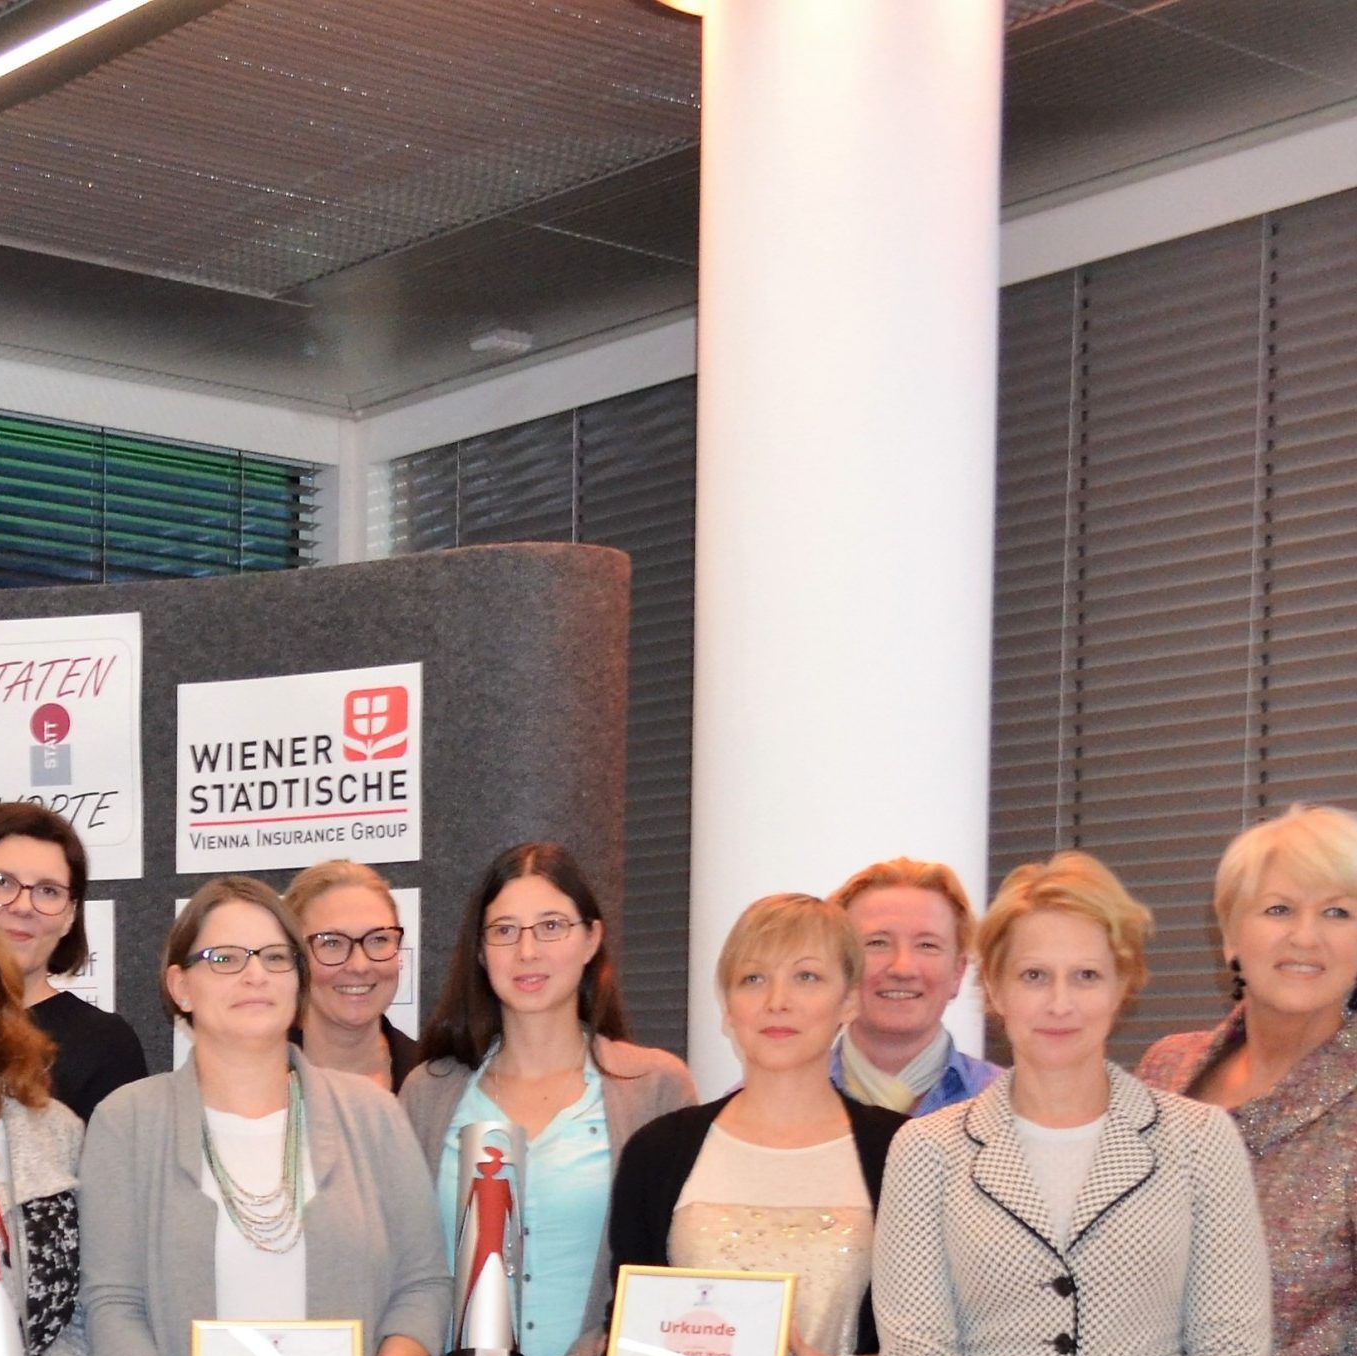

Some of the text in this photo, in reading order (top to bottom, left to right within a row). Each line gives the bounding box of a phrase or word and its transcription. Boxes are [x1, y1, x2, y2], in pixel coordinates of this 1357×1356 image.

[44, 720, 58, 769] STATT
[189, 734, 333, 773] WIENER
[189, 769, 407, 814] STÄDTISCHE
[659, 1320, 736, 1337] Urkunde
